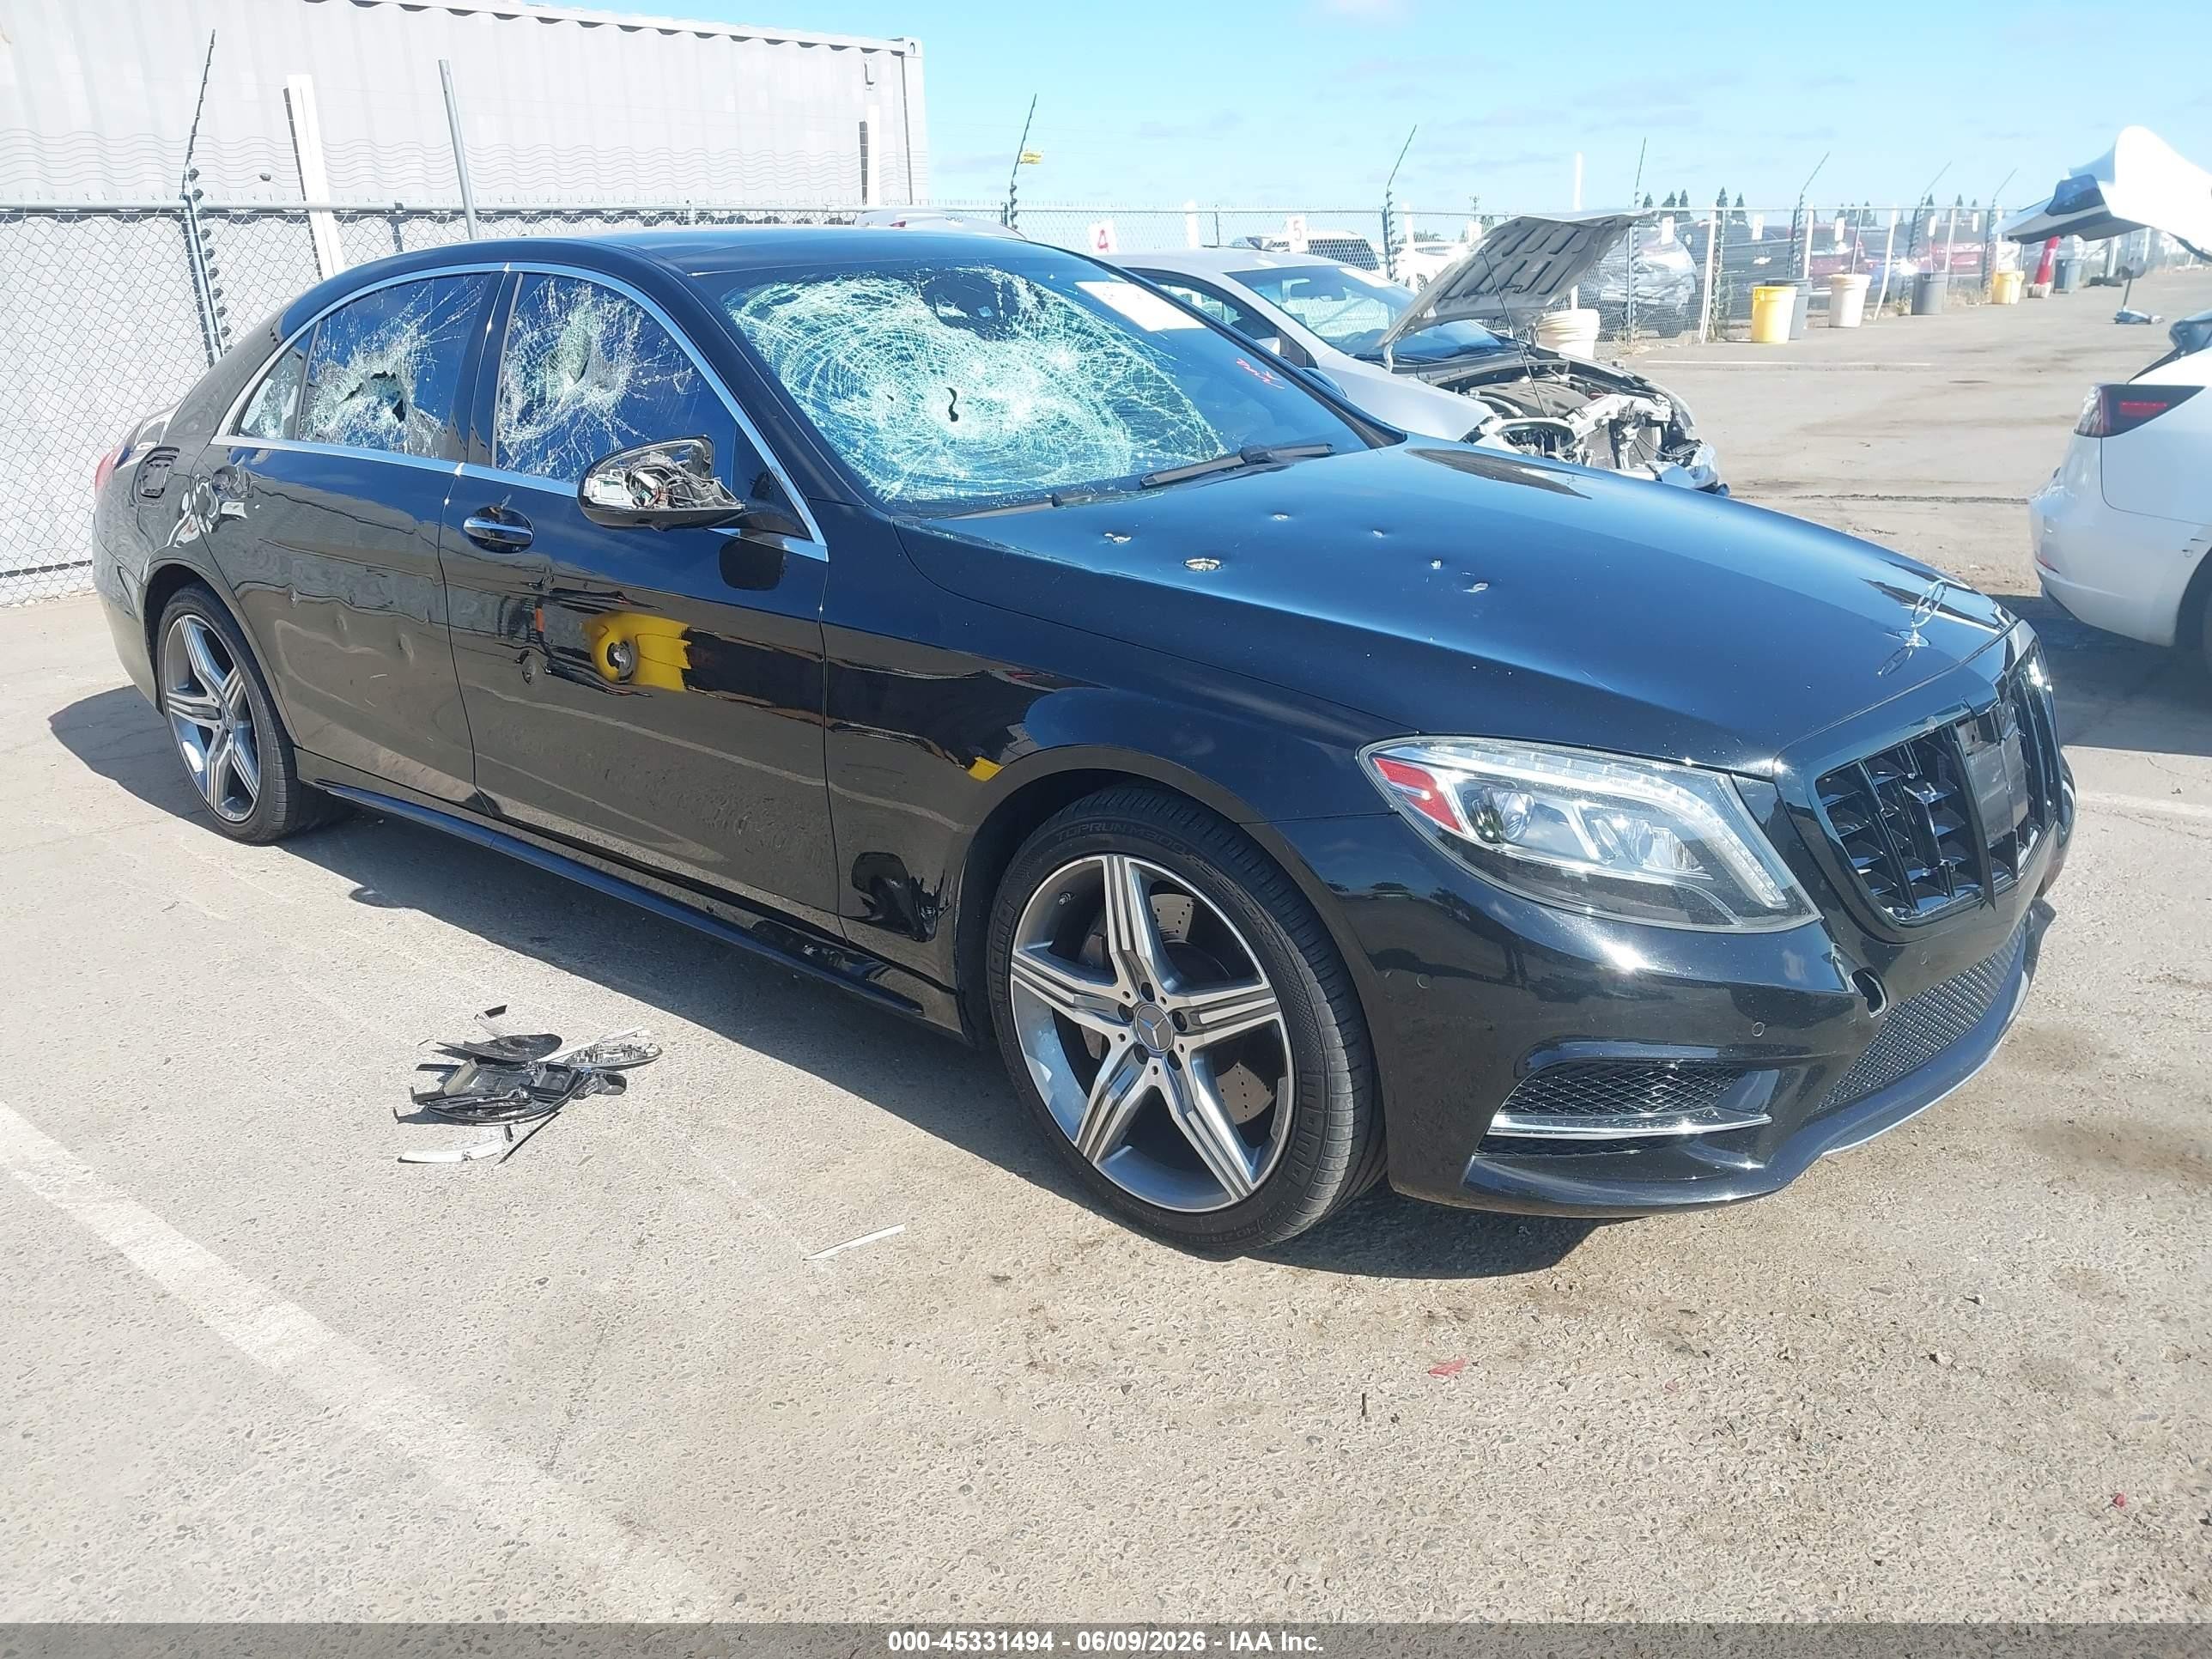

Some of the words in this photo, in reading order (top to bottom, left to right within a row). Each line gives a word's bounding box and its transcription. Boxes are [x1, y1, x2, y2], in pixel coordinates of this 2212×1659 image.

[1293, 219, 1302, 241] 5
[1054, 823, 1127, 841] TOPRUN
[1127, 824, 1185, 853] M300
